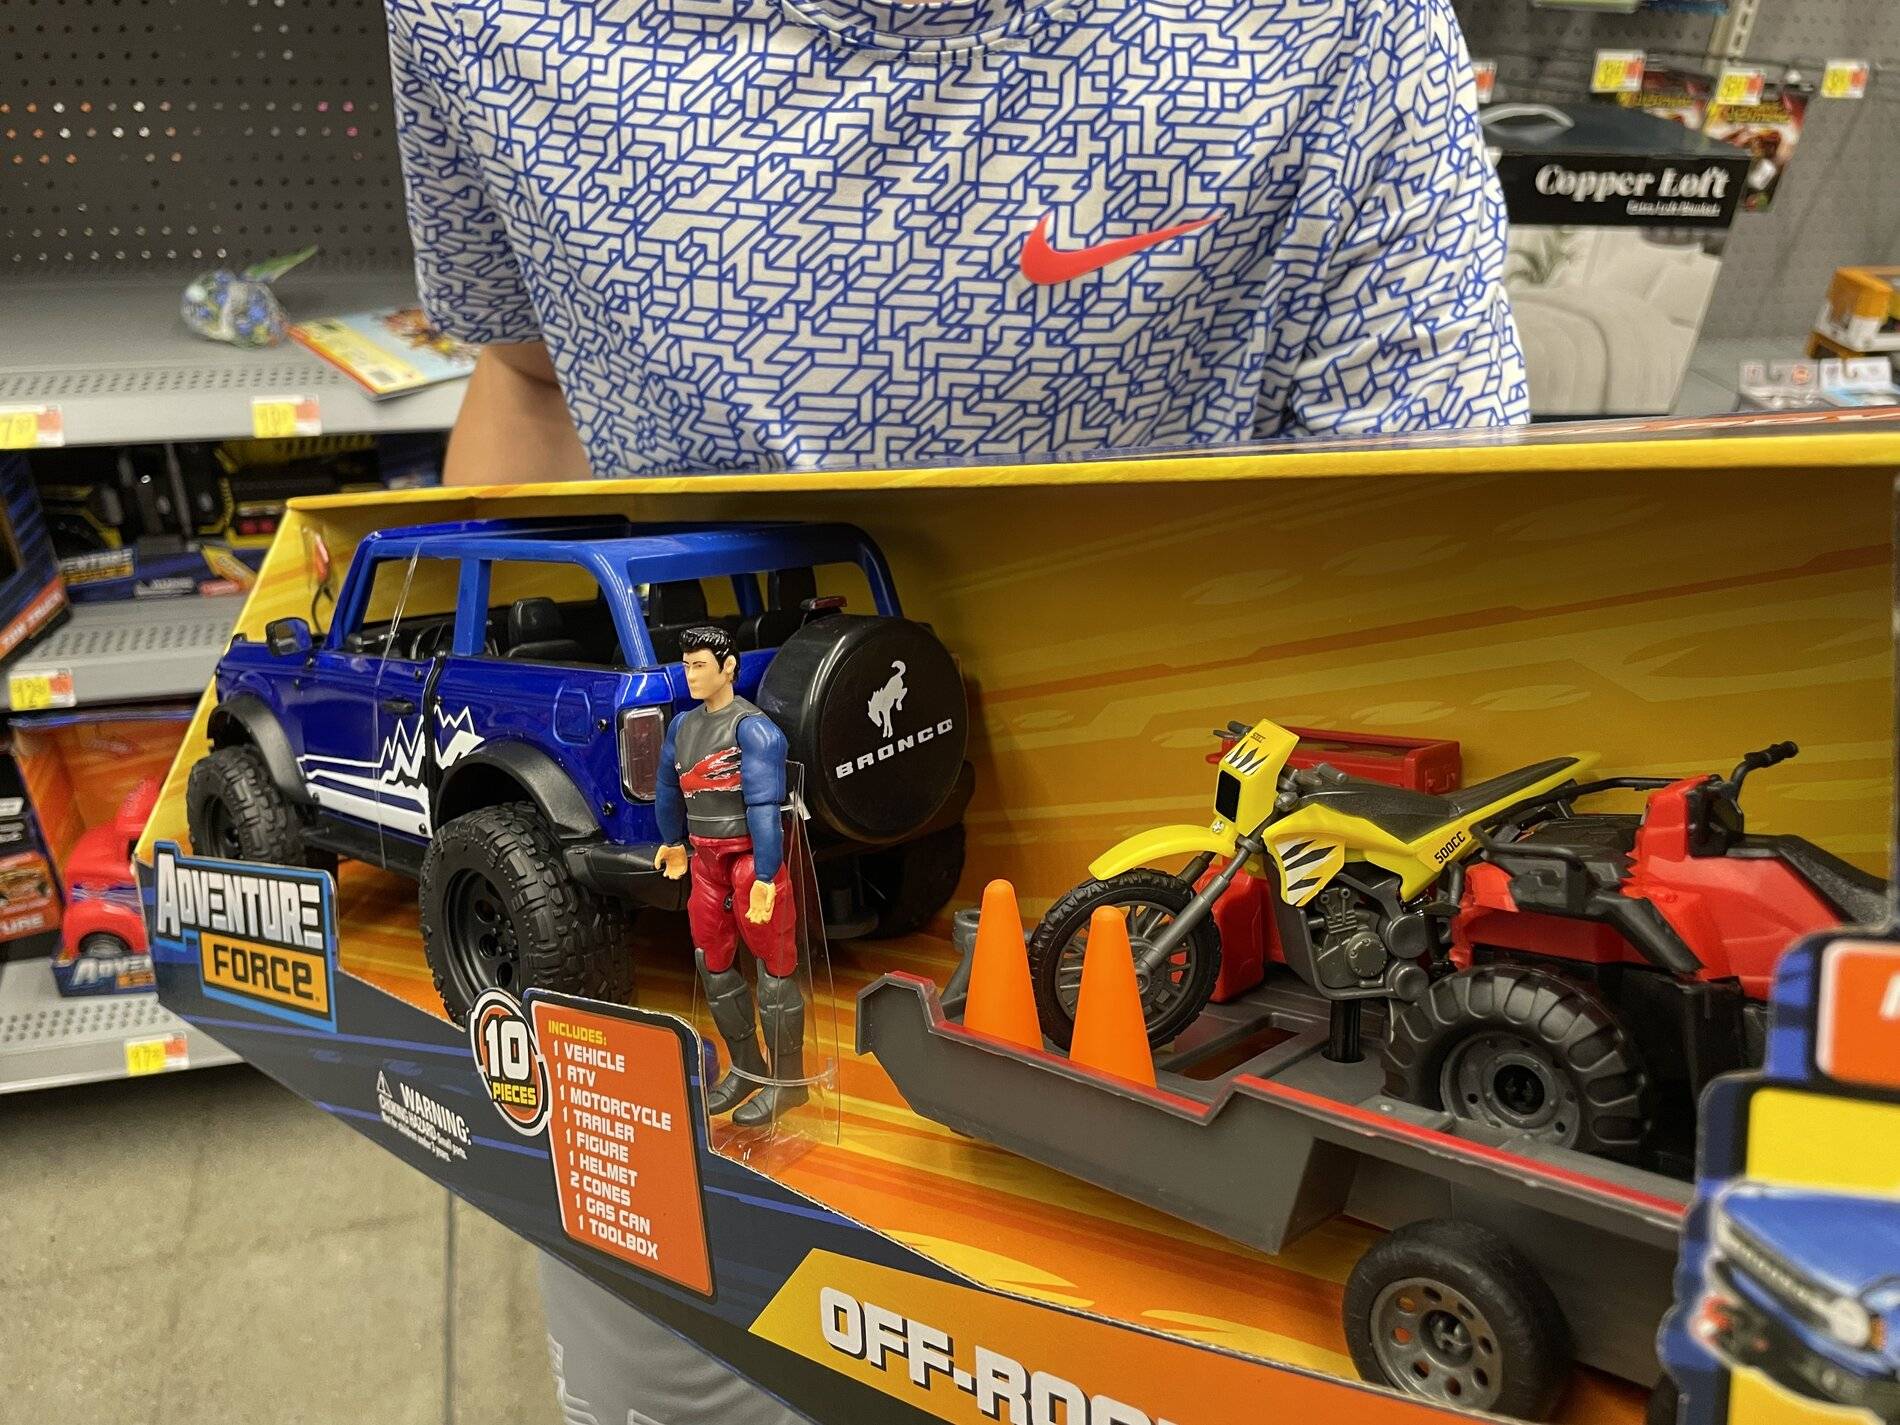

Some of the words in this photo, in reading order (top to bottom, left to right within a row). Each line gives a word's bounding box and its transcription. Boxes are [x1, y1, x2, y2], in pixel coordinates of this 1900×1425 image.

[1535, 164, 1655, 202] Copper
[1658, 166, 1730, 199] Loft
[835, 718, 954, 779] BRONCO
[1433, 831, 1466, 864] 500CC
[157, 853, 324, 950] ADVENTURE
[212, 943, 315, 1000] FORCE
[485, 1018, 531, 1082] 10
[548, 1019, 608, 1046] INCLUDES:
[553, 1040, 559, 1057] 1
[564, 1041, 625, 1073] VEHICLE
[557, 1062, 562, 1079] 1
[567, 1065, 597, 1088] ATV
[492, 1080, 537, 1106] PIECES
[560, 1084, 565, 1101] 1
[570, 1086, 672, 1131] MOTORCYCLE
[400, 1082, 472, 1146] WARNING:
[563, 1106, 568, 1123] 1
[573, 1109, 635, 1143] TRAILER
[566, 1128, 571, 1145] 1
[576, 1131, 629, 1164] FIGURE
[569, 1150, 575, 1167] 1
[580, 1153, 638, 1187] HELMET
[570, 1170, 580, 1189] 2
[583, 1175, 631, 1208] CONES
[575, 1193, 581, 1209] 1
[586, 1197, 615, 1222] GAS
[619, 1210, 651, 1236] CAN
[578, 1214, 584, 1231] 1
[589, 1218, 659, 1261] TOOLBOX
[820, 1286, 1176, 1425] OFF-RO
